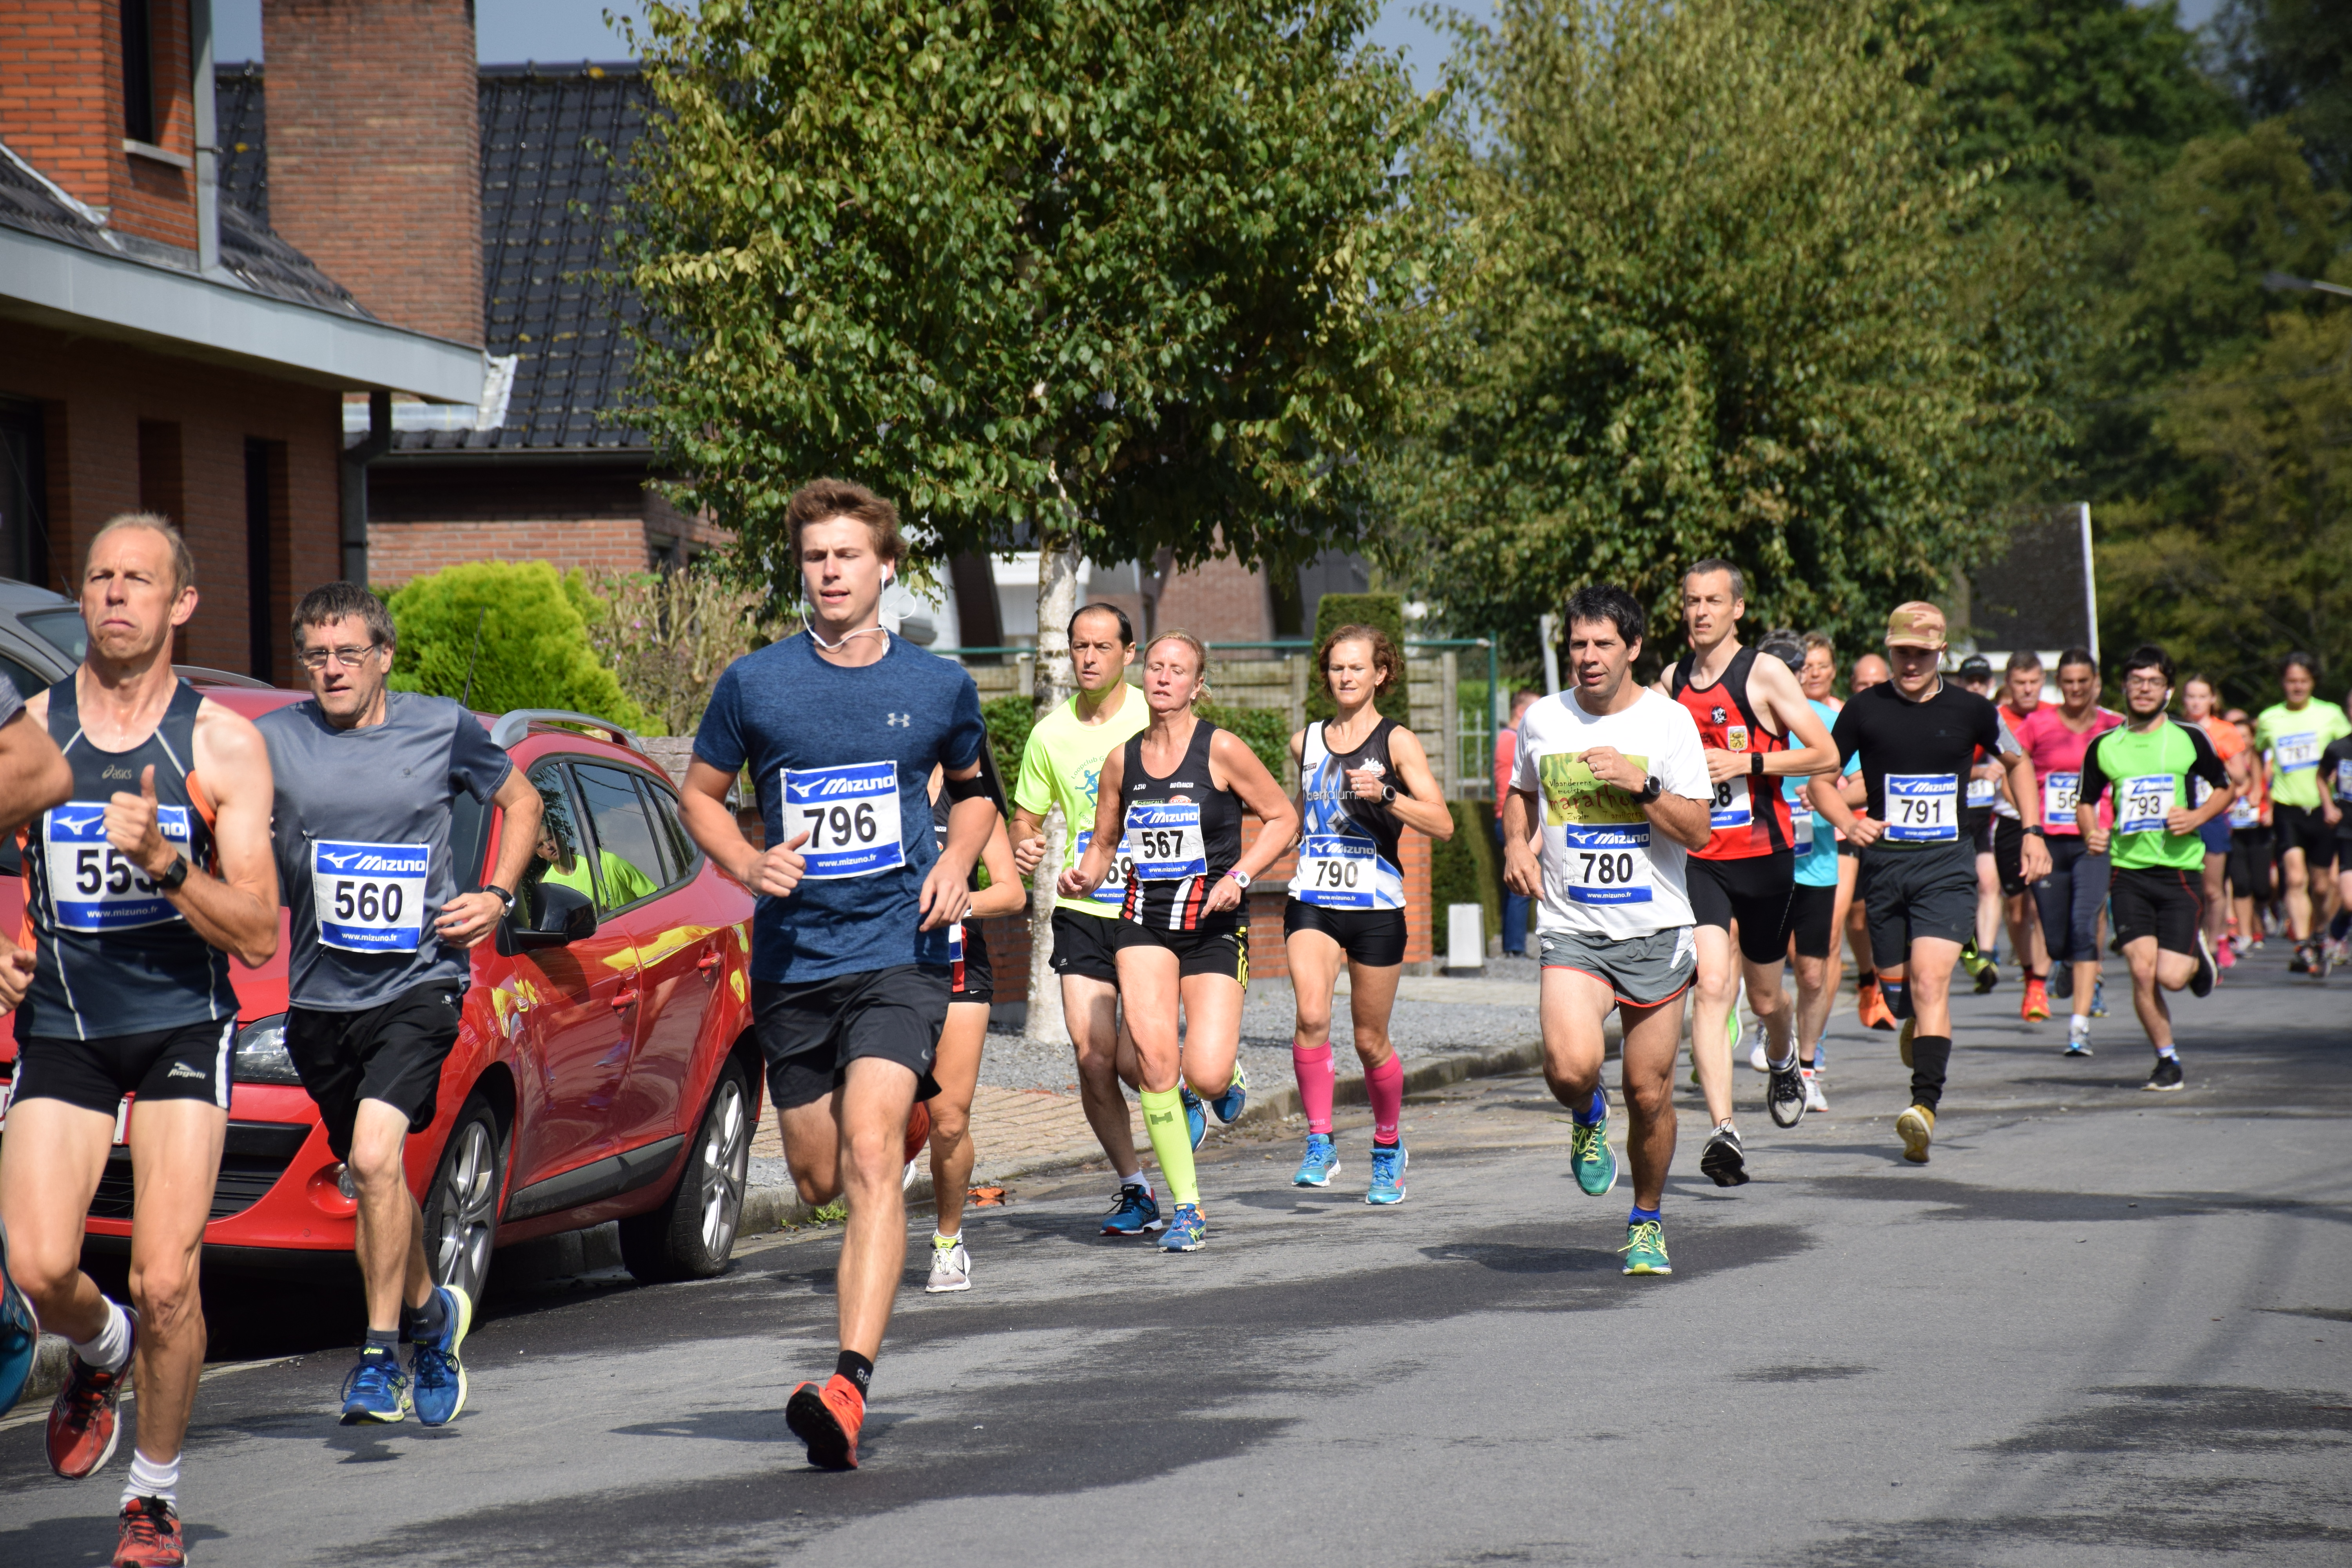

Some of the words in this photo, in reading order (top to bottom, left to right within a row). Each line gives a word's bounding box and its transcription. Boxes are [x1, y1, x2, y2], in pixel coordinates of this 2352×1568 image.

[1071, 757, 1098, 779] Loopclub
[820, 775, 895, 796] Mizuno
[1549, 779, 1592, 788] Vlaanderens
[2059, 791, 2077, 808] 56
[2129, 795, 2160, 817] 793
[1078, 811, 1094, 825] Loop
[1149, 812, 1198, 824] Mizuno
[1567, 811, 1590, 820] Zwalm
[1901, 799, 1941, 823] 791
[802, 802, 877, 849] 796
[1142, 830, 1184, 859] 567
[1594, 833, 1650, 844] Mizuno
[1327, 843, 1375, 855] Mizuno
[354, 855, 426, 872] Mizuno
[817, 853, 877, 867] www.mizuno.fr
[1580, 852, 1633, 884] 780
[1105, 856, 1132, 884] 69
[1316, 860, 1359, 888] 790
[334, 880, 403, 923] 560
[87, 906, 158, 918] www.mizuno.fr
[341, 932, 397, 942] www.mizuno.fr
[167, 1068, 205, 1080] Rogelli
